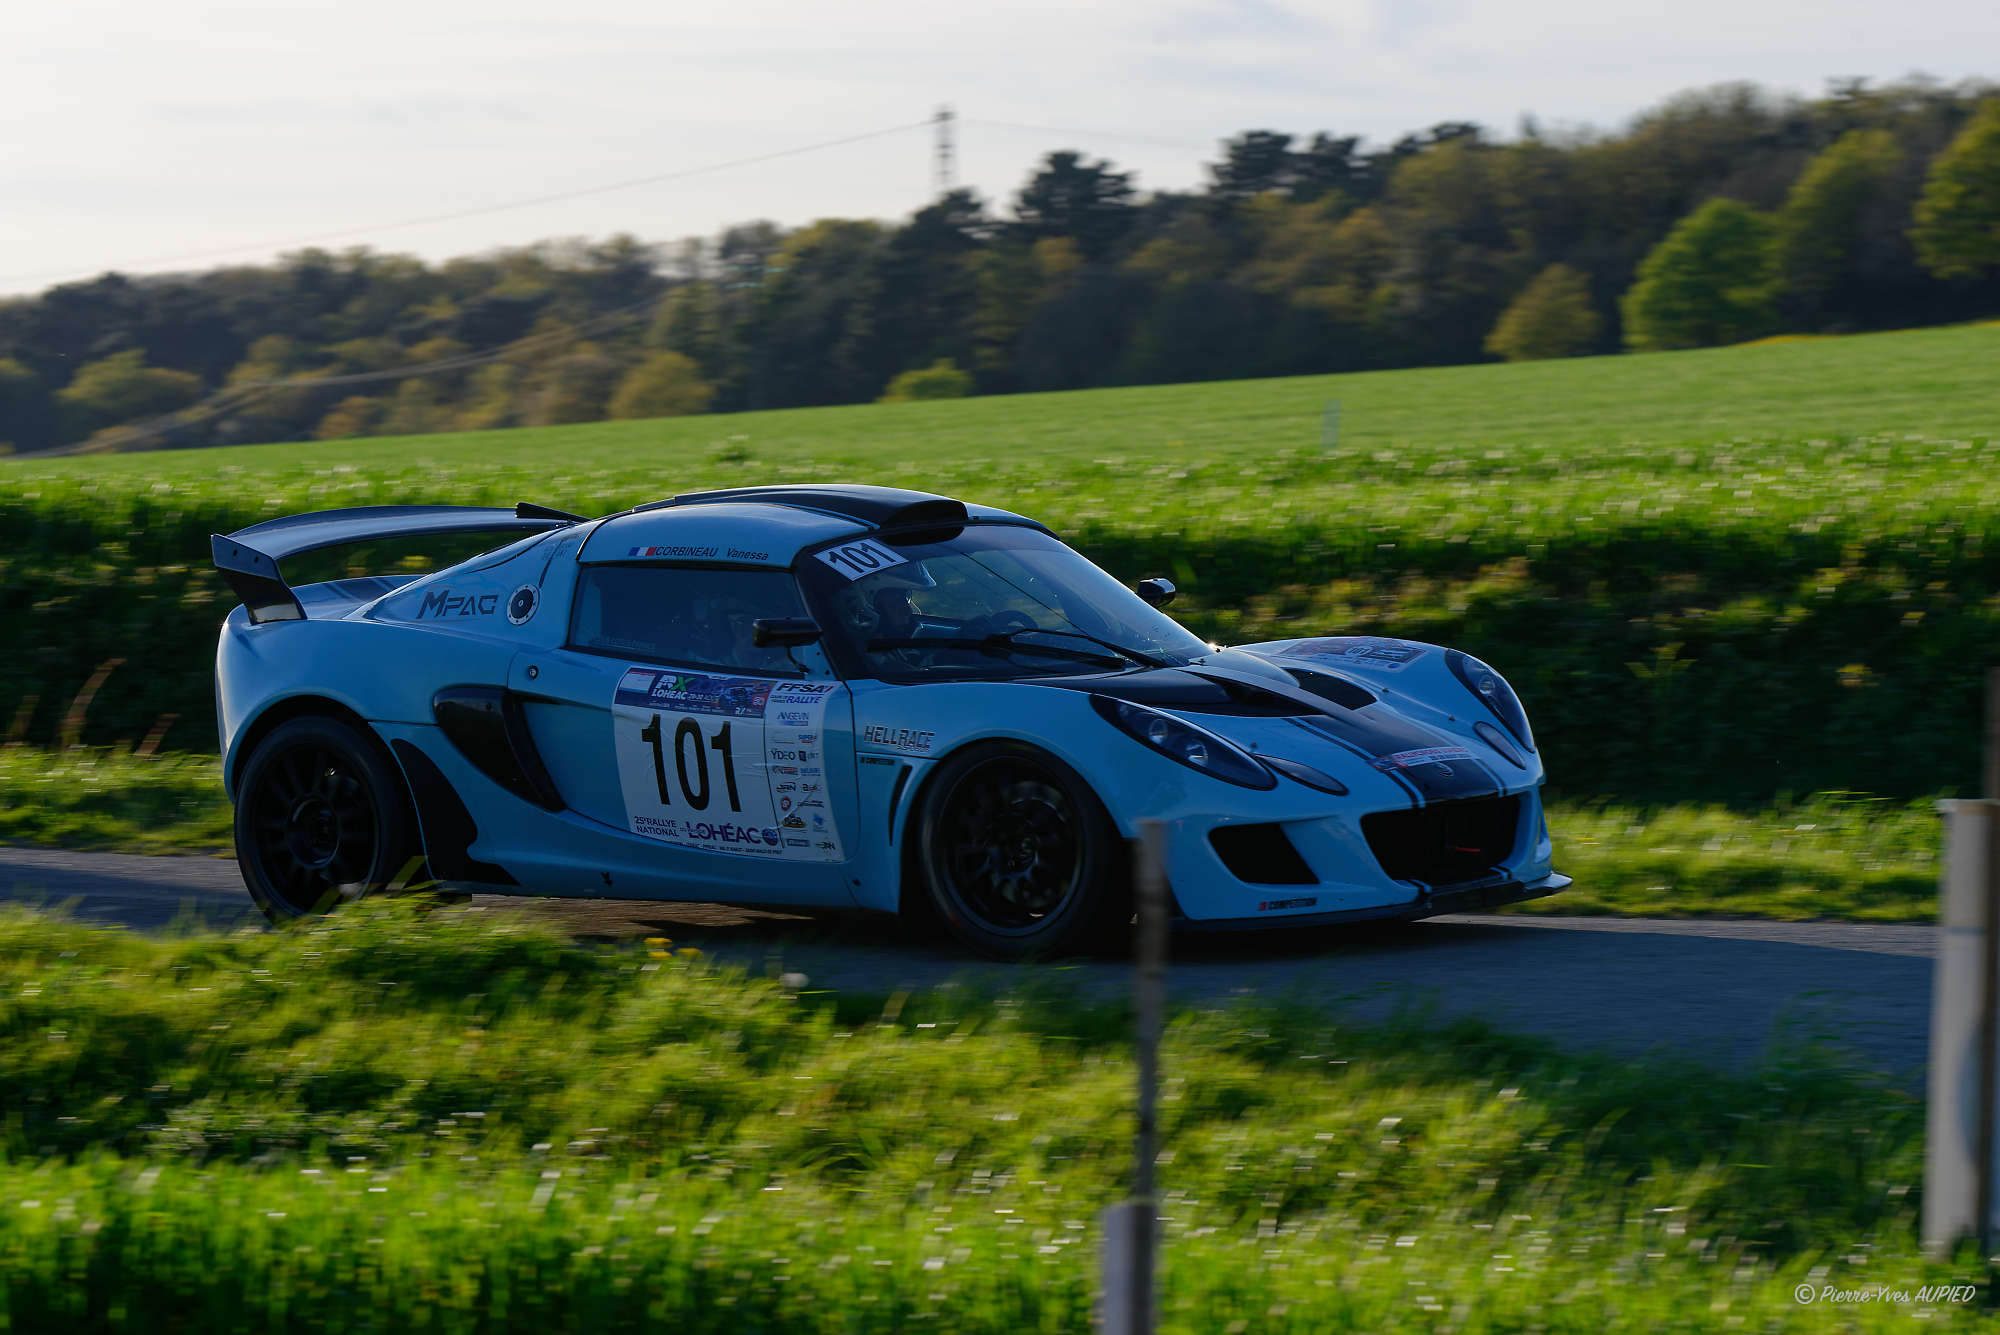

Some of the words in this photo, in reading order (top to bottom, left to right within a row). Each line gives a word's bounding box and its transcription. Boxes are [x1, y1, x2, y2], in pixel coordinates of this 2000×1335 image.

[655, 546, 719, 557] CORBINEAU
[726, 547, 769, 561] Vanessa
[829, 542, 897, 574] 101
[651, 688, 688, 701] LOHEAC
[776, 683, 825, 693] FFSA
[786, 695, 823, 704] RALLYE
[863, 725, 936, 748] HELLRACE
[641, 713, 742, 813] 101
[646, 817, 677, 828] RALLYE
[636, 826, 680, 838] NATIONAL
[685, 820, 762, 844] LOHÉAC
